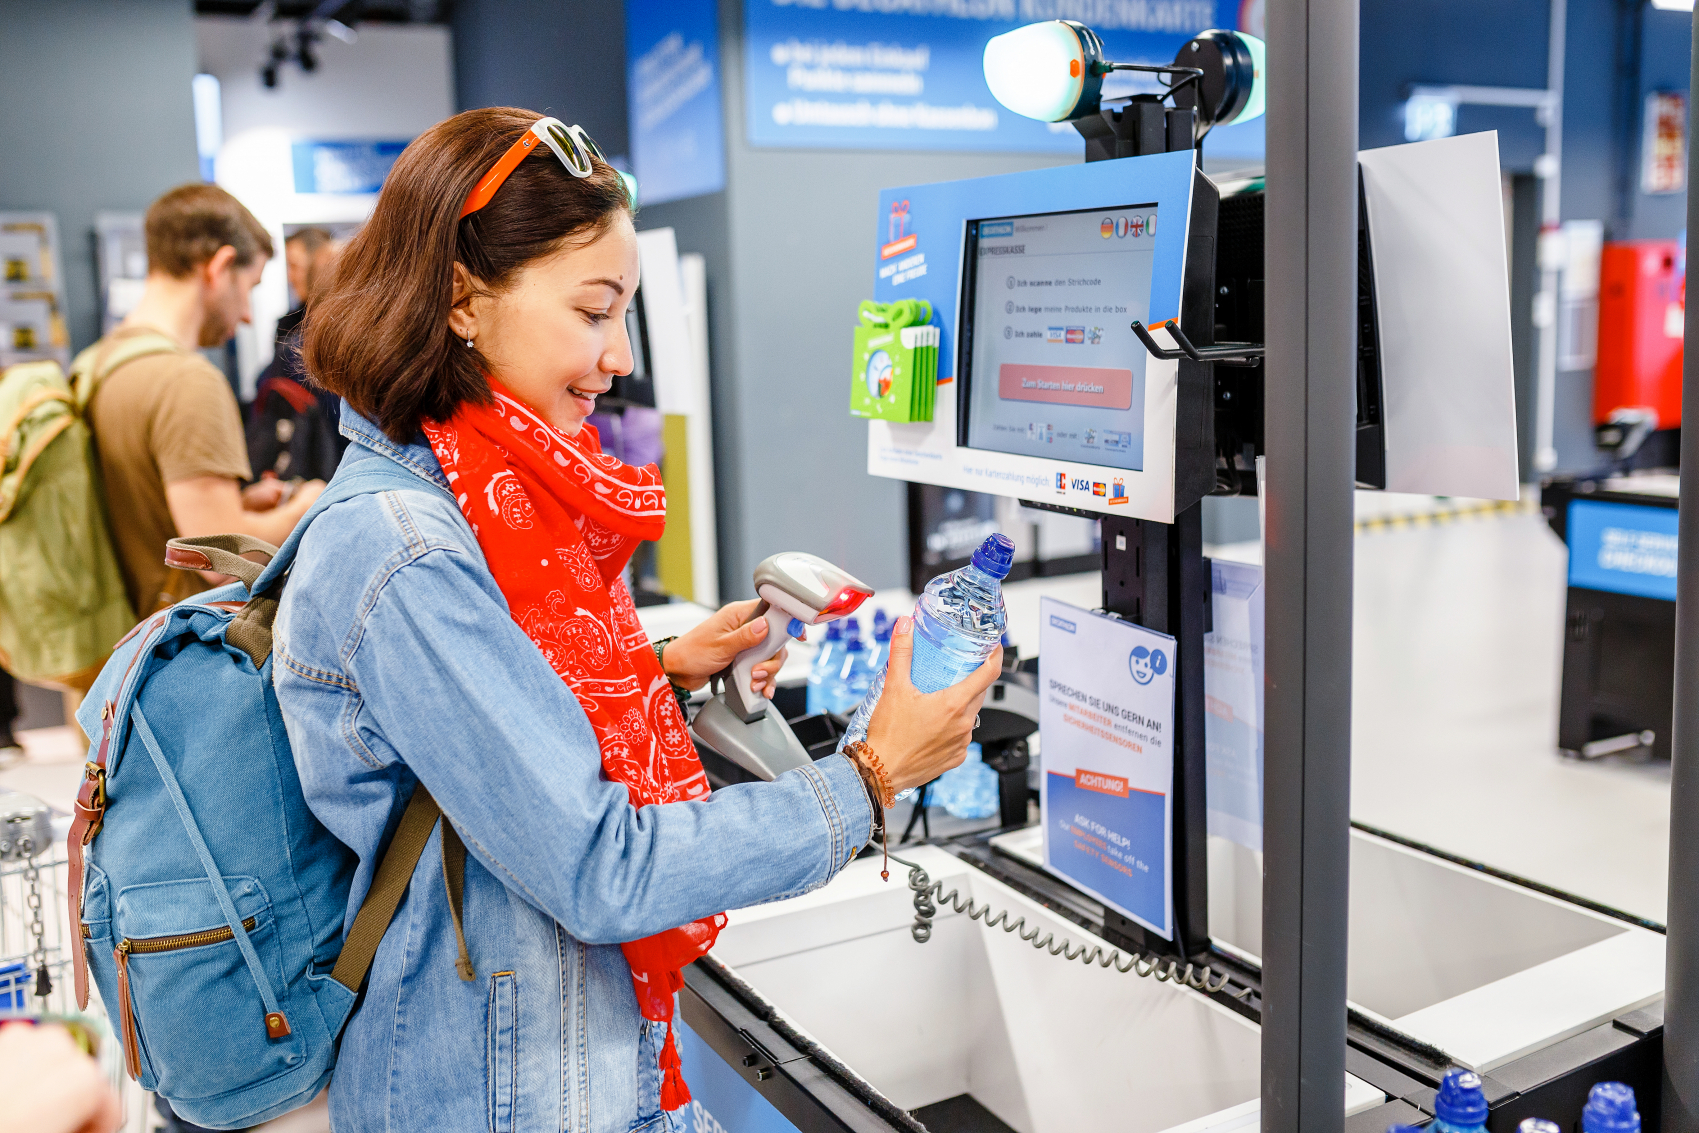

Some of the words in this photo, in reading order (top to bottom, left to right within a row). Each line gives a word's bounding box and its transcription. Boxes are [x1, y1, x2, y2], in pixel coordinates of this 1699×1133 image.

[1054, 278, 1067, 287] den
[1068, 277, 1102, 287] Strichcode
[1044, 305, 1062, 313] meine
[1064, 304, 1093, 313] Produkte
[1095, 304, 1101, 313] in
[1102, 304, 1113, 313] die
[1115, 304, 1128, 313] box
[1022, 377, 1036, 389] Zum
[1037, 379, 1061, 391] Starten
[1062, 380, 1075, 392] hier
[1076, 381, 1104, 394] drücken
[1071, 477, 1090, 492] VISA
[1048, 678, 1088, 704] SPRECHEN
[1088, 694, 1102, 710] SIE
[1102, 700, 1120, 718] UNS
[1120, 708, 1145, 727] GERN
[1146, 717, 1162, 733] AN!
[1113, 722, 1149, 743] entfernen
[1149, 735, 1162, 748] die
[1079, 772, 1124, 793] ACHTUNG!
[1074, 813, 1091, 830] ASK
[1091, 820, 1107, 839] FOR
[1107, 829, 1131, 851] HELP!
[1123, 854, 1136, 866] off
[1136, 859, 1149, 874] the
